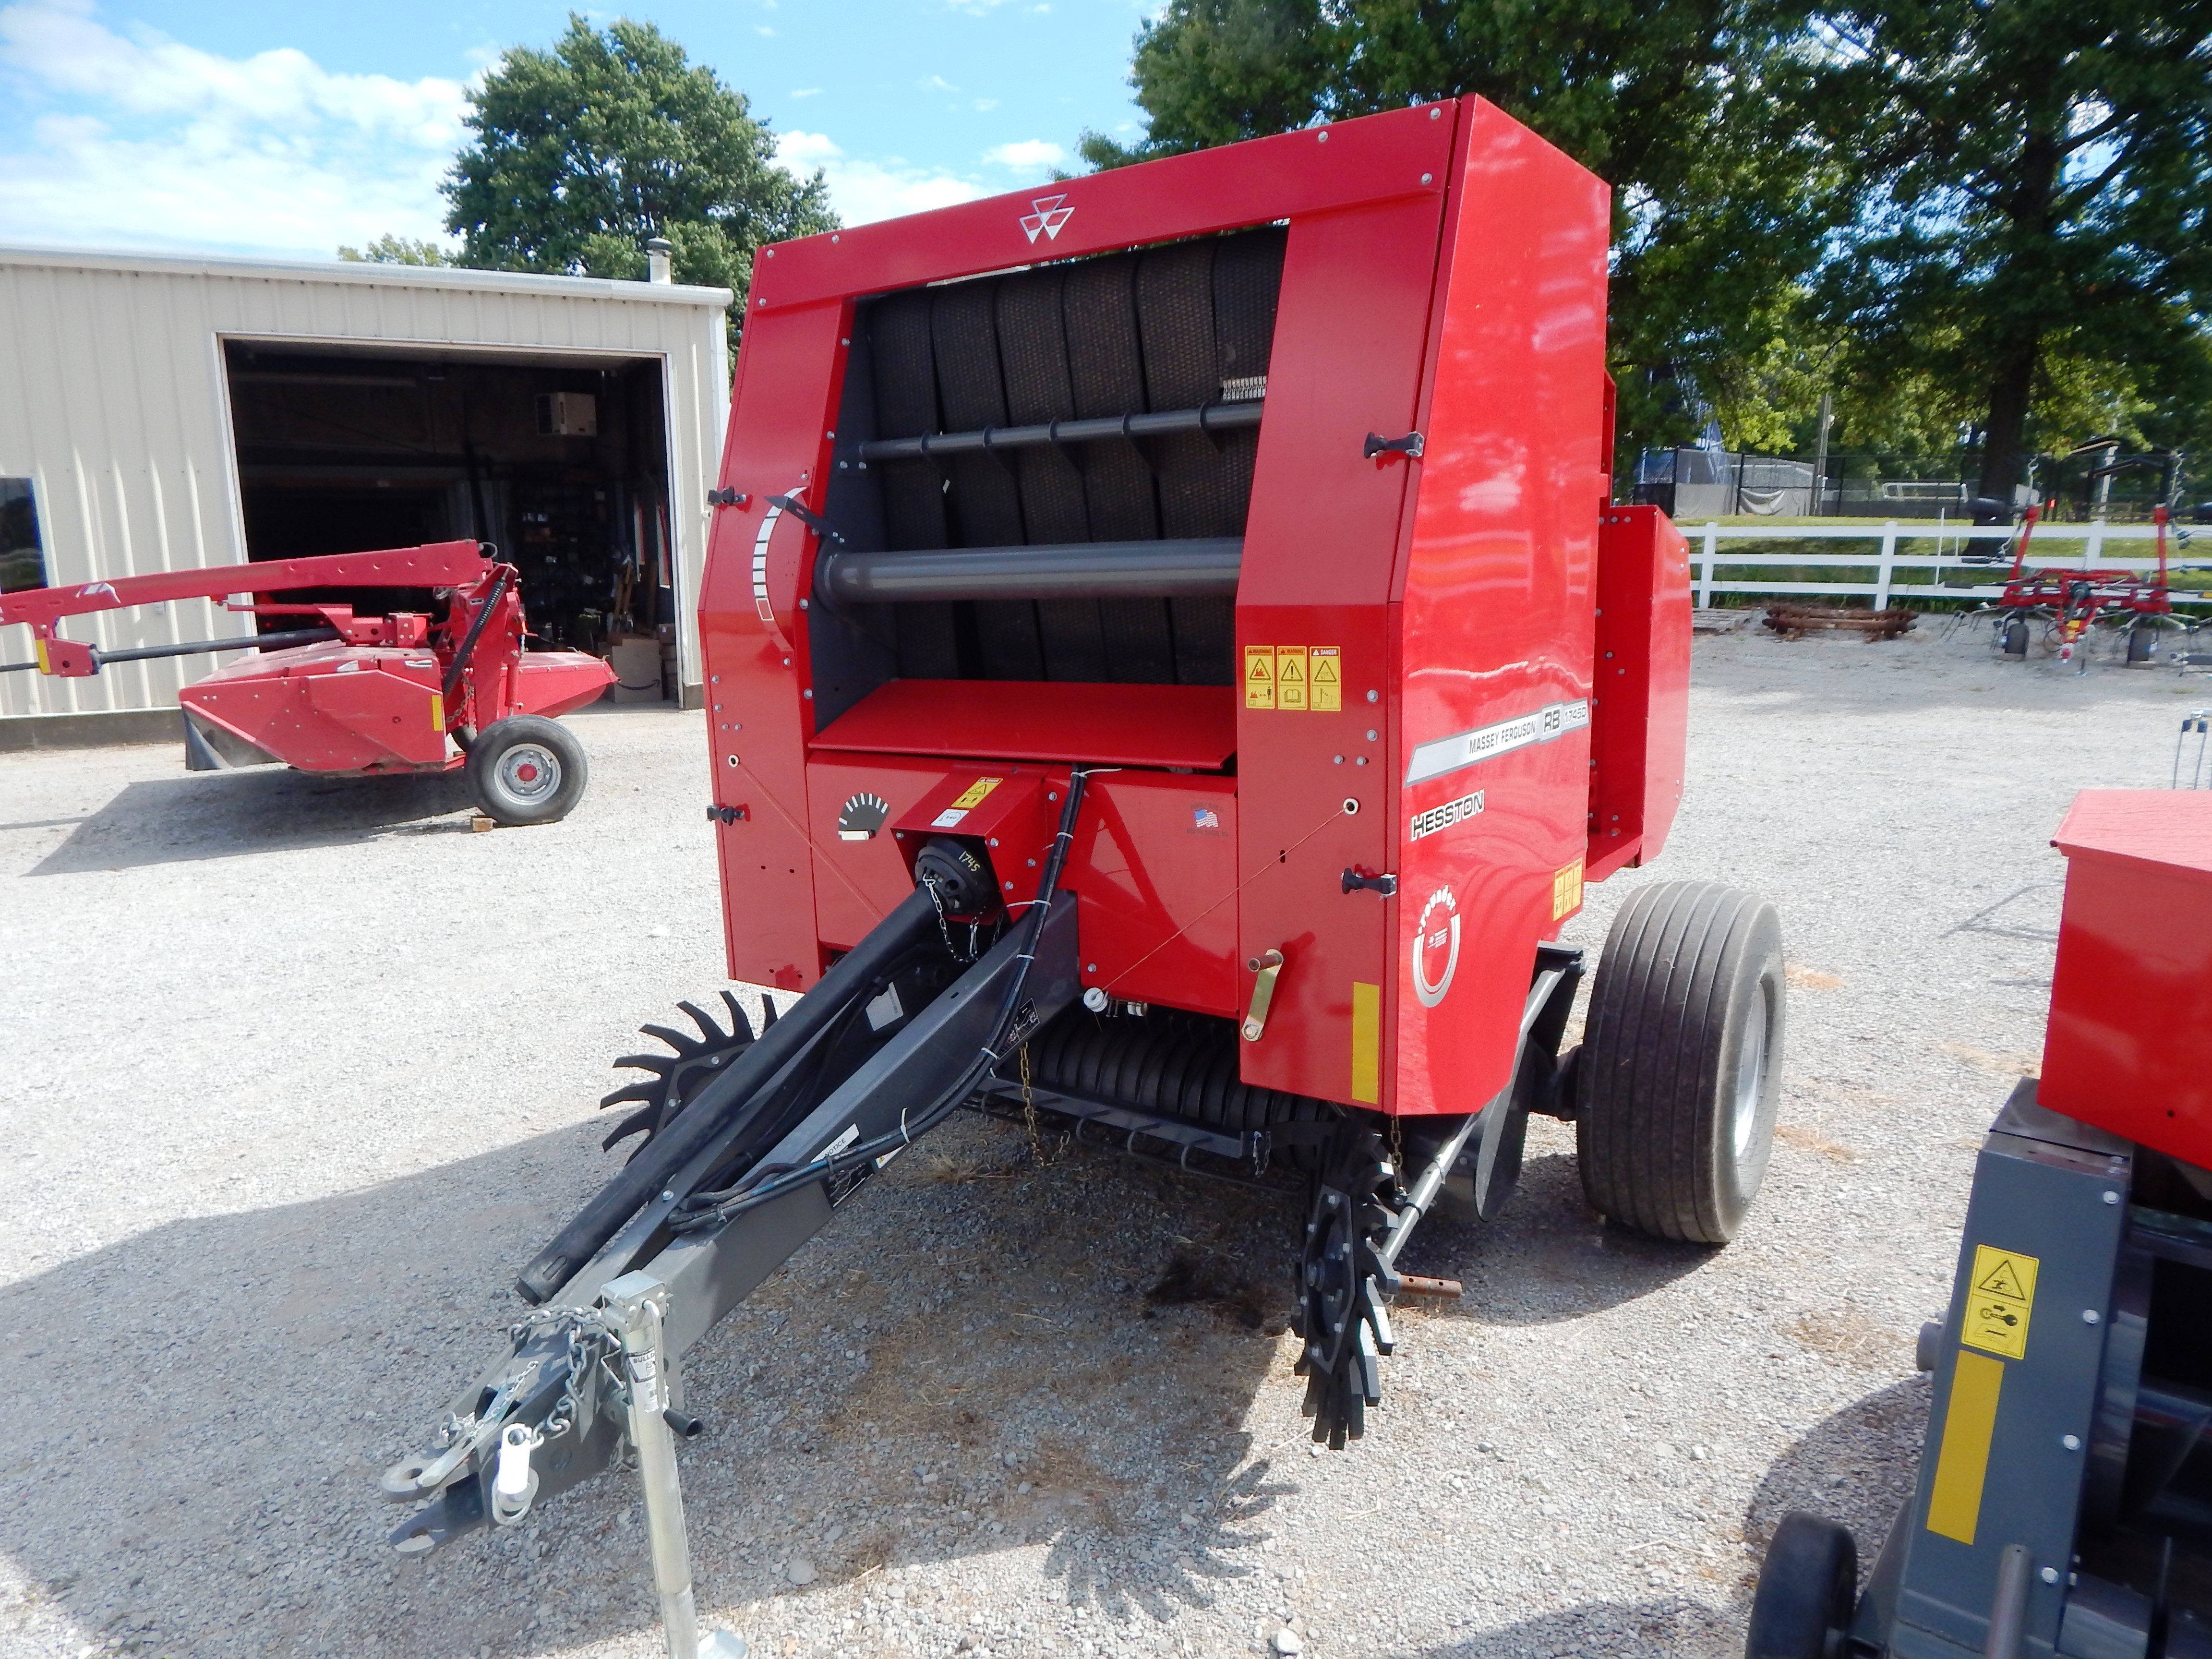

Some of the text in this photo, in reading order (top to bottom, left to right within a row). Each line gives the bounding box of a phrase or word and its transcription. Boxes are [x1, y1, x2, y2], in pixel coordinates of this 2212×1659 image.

[1468, 730, 1499, 754] MASSEY
[1501, 720, 1537, 744] FERGUSON
[1543, 708, 1561, 733] RB
[1412, 790, 1484, 840] HESSTON
[958, 851, 981, 872] 1745
[824, 1137, 846, 1157] NOTICE
[633, 1352, 655, 1364] BULLD
